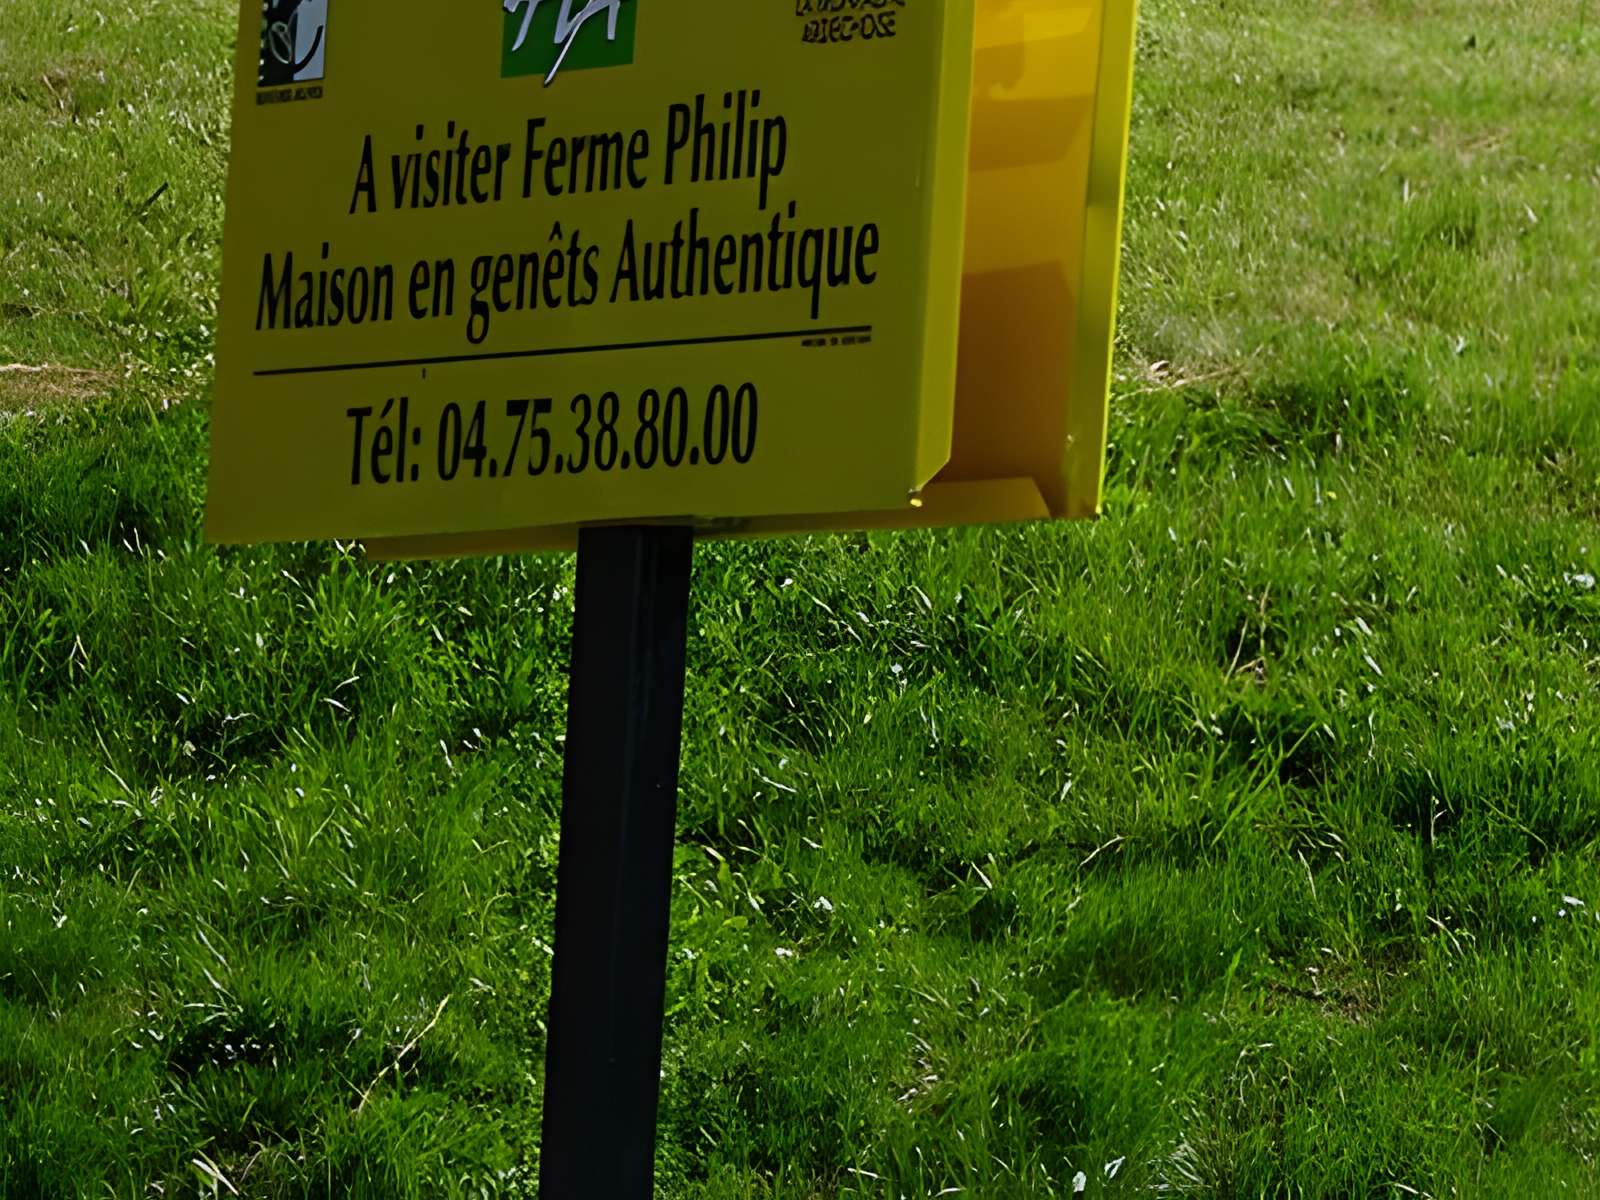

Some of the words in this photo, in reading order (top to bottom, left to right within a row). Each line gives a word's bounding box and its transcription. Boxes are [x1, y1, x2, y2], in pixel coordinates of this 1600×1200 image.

[350, 135, 376, 215] A
[391, 121, 511, 207] visiter
[522, 117, 650, 198] Ferme
[664, 89, 788, 209] Philip
[254, 242, 394, 332] Maison
[409, 252, 455, 319] en
[466, 221, 598, 345] genêts
[609, 201, 880, 320] Authentique
[346, 397, 422, 486] Tél:
[437, 382, 758, 479] 04.75.38.80.00
